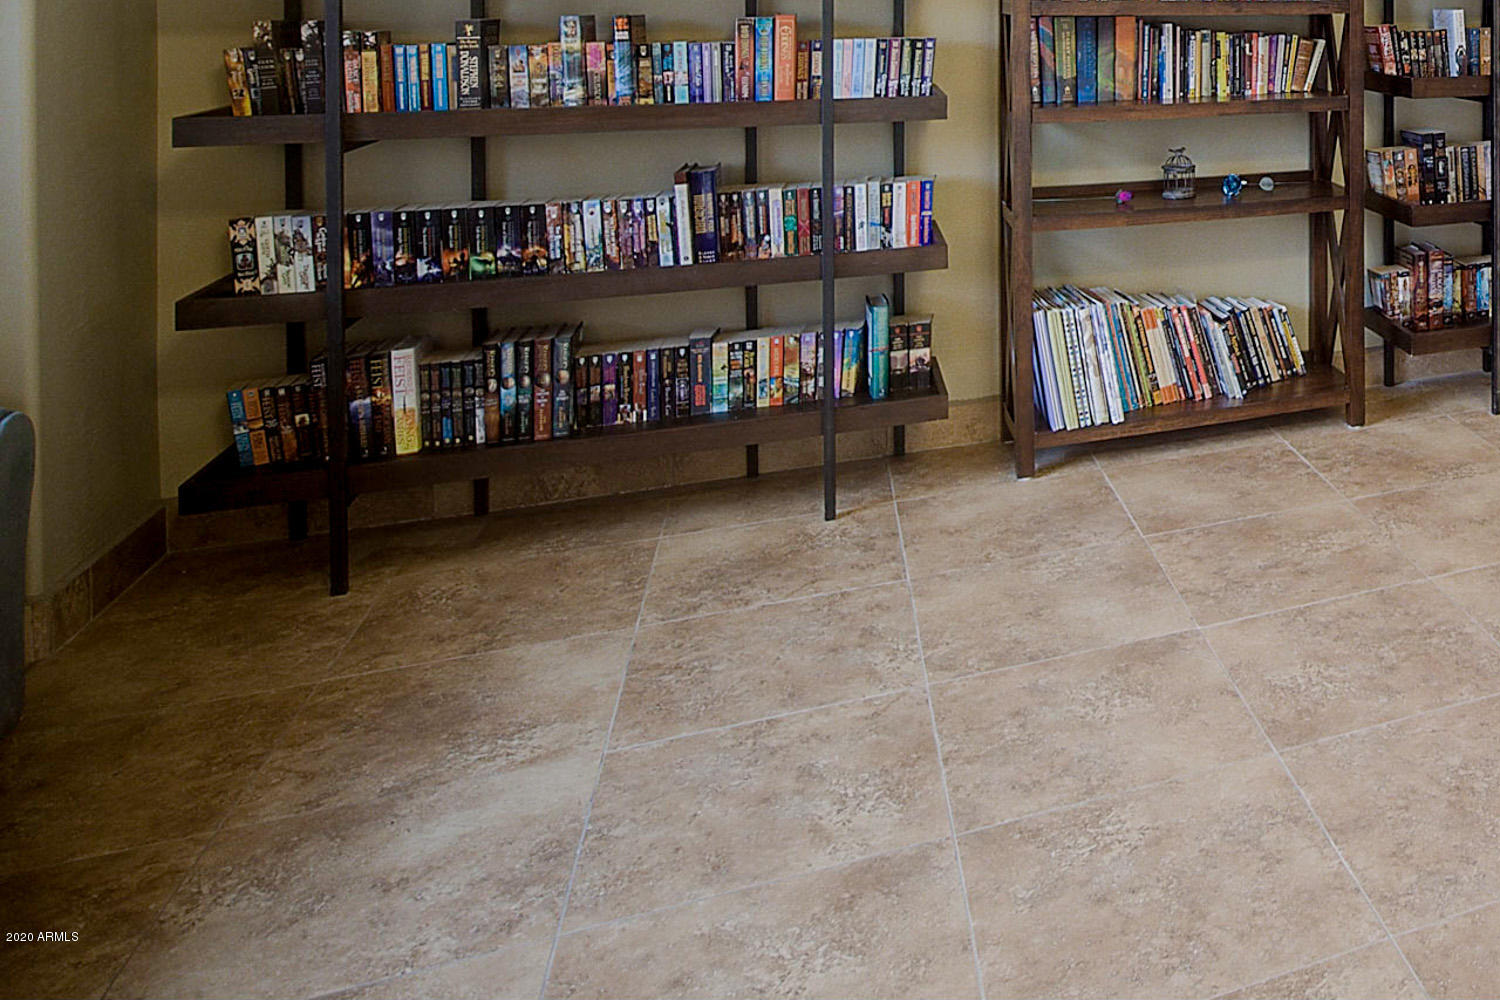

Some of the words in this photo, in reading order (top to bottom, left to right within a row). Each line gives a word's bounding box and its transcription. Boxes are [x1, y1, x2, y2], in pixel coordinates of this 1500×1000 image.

[459, 50, 470, 95] DONALDSON
[469, 55, 479, 88] STEPHEN
[370, 359, 385, 390] FEIST
[394, 354, 408, 396] FEIST
